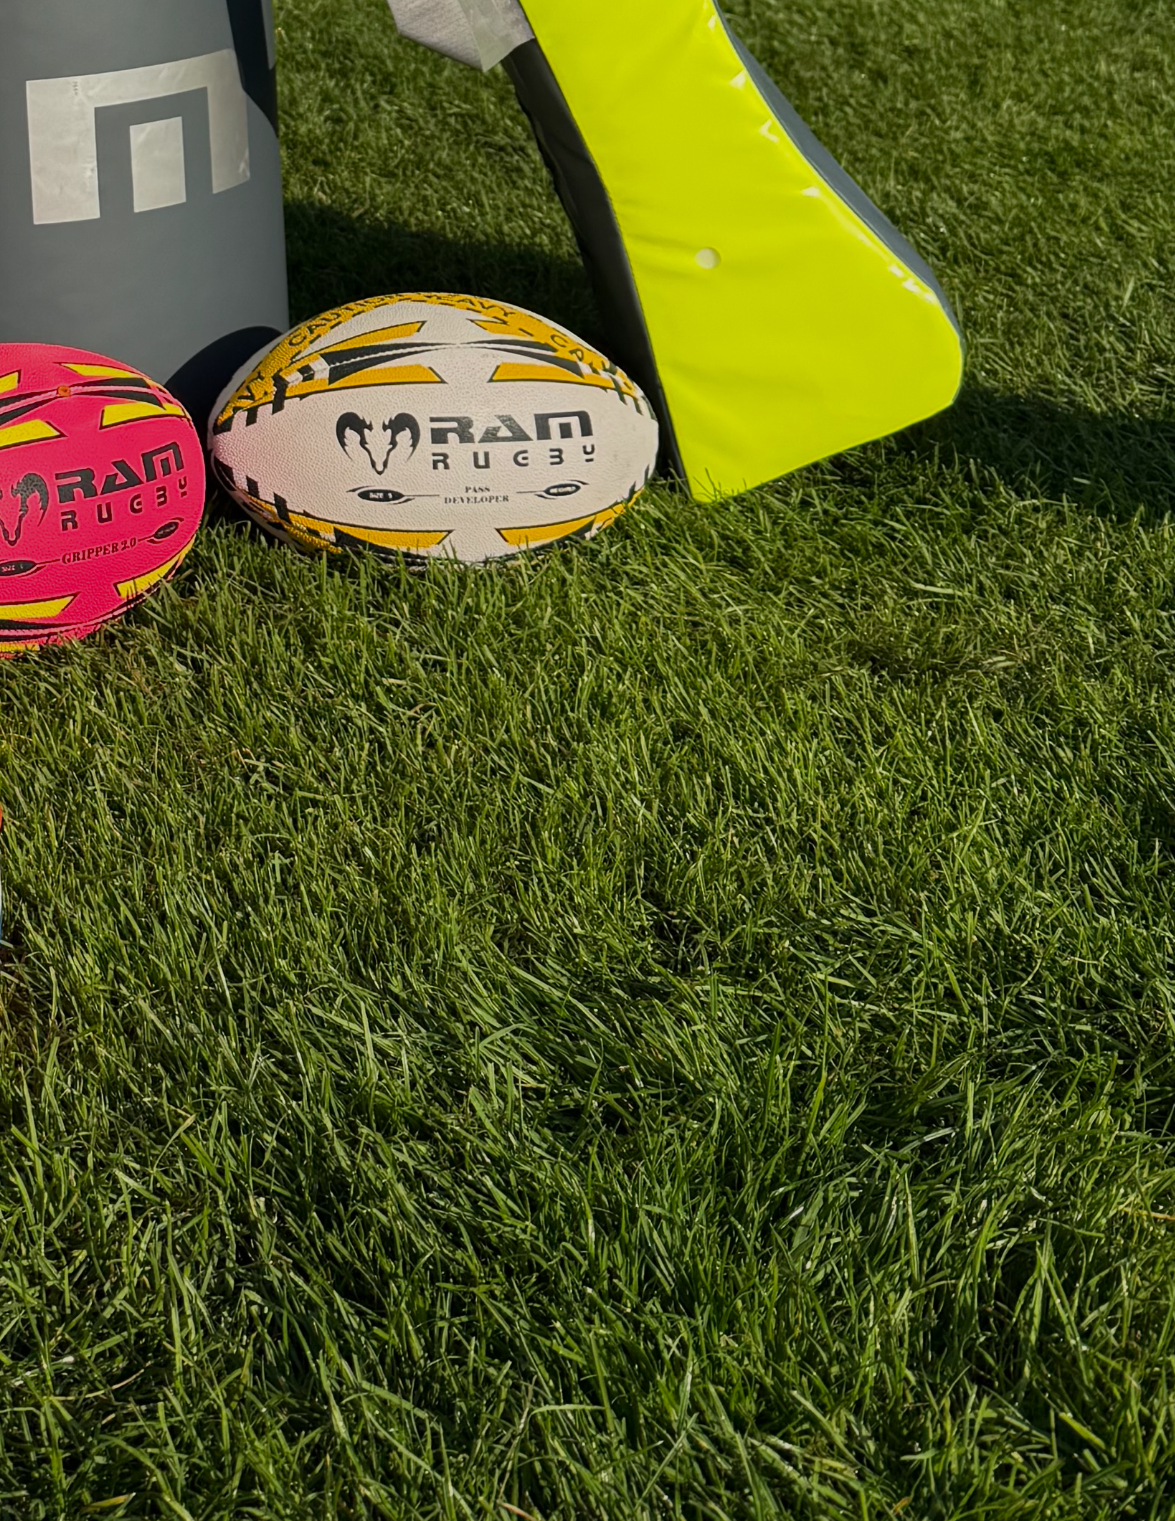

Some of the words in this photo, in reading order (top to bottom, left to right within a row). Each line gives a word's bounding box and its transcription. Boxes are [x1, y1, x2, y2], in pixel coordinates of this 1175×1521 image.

[430, 409, 593, 444] RAM
[432, 444, 595, 471] RUGBY
[55, 441, 186, 504] RAM
[60, 475, 188, 532] RUGBY
[444, 494, 510, 505] DEVELOPER
[465, 485, 491, 494] PASS
[61, 543, 119, 565] GRIPPER
[120, 537, 137, 551] 2.0
